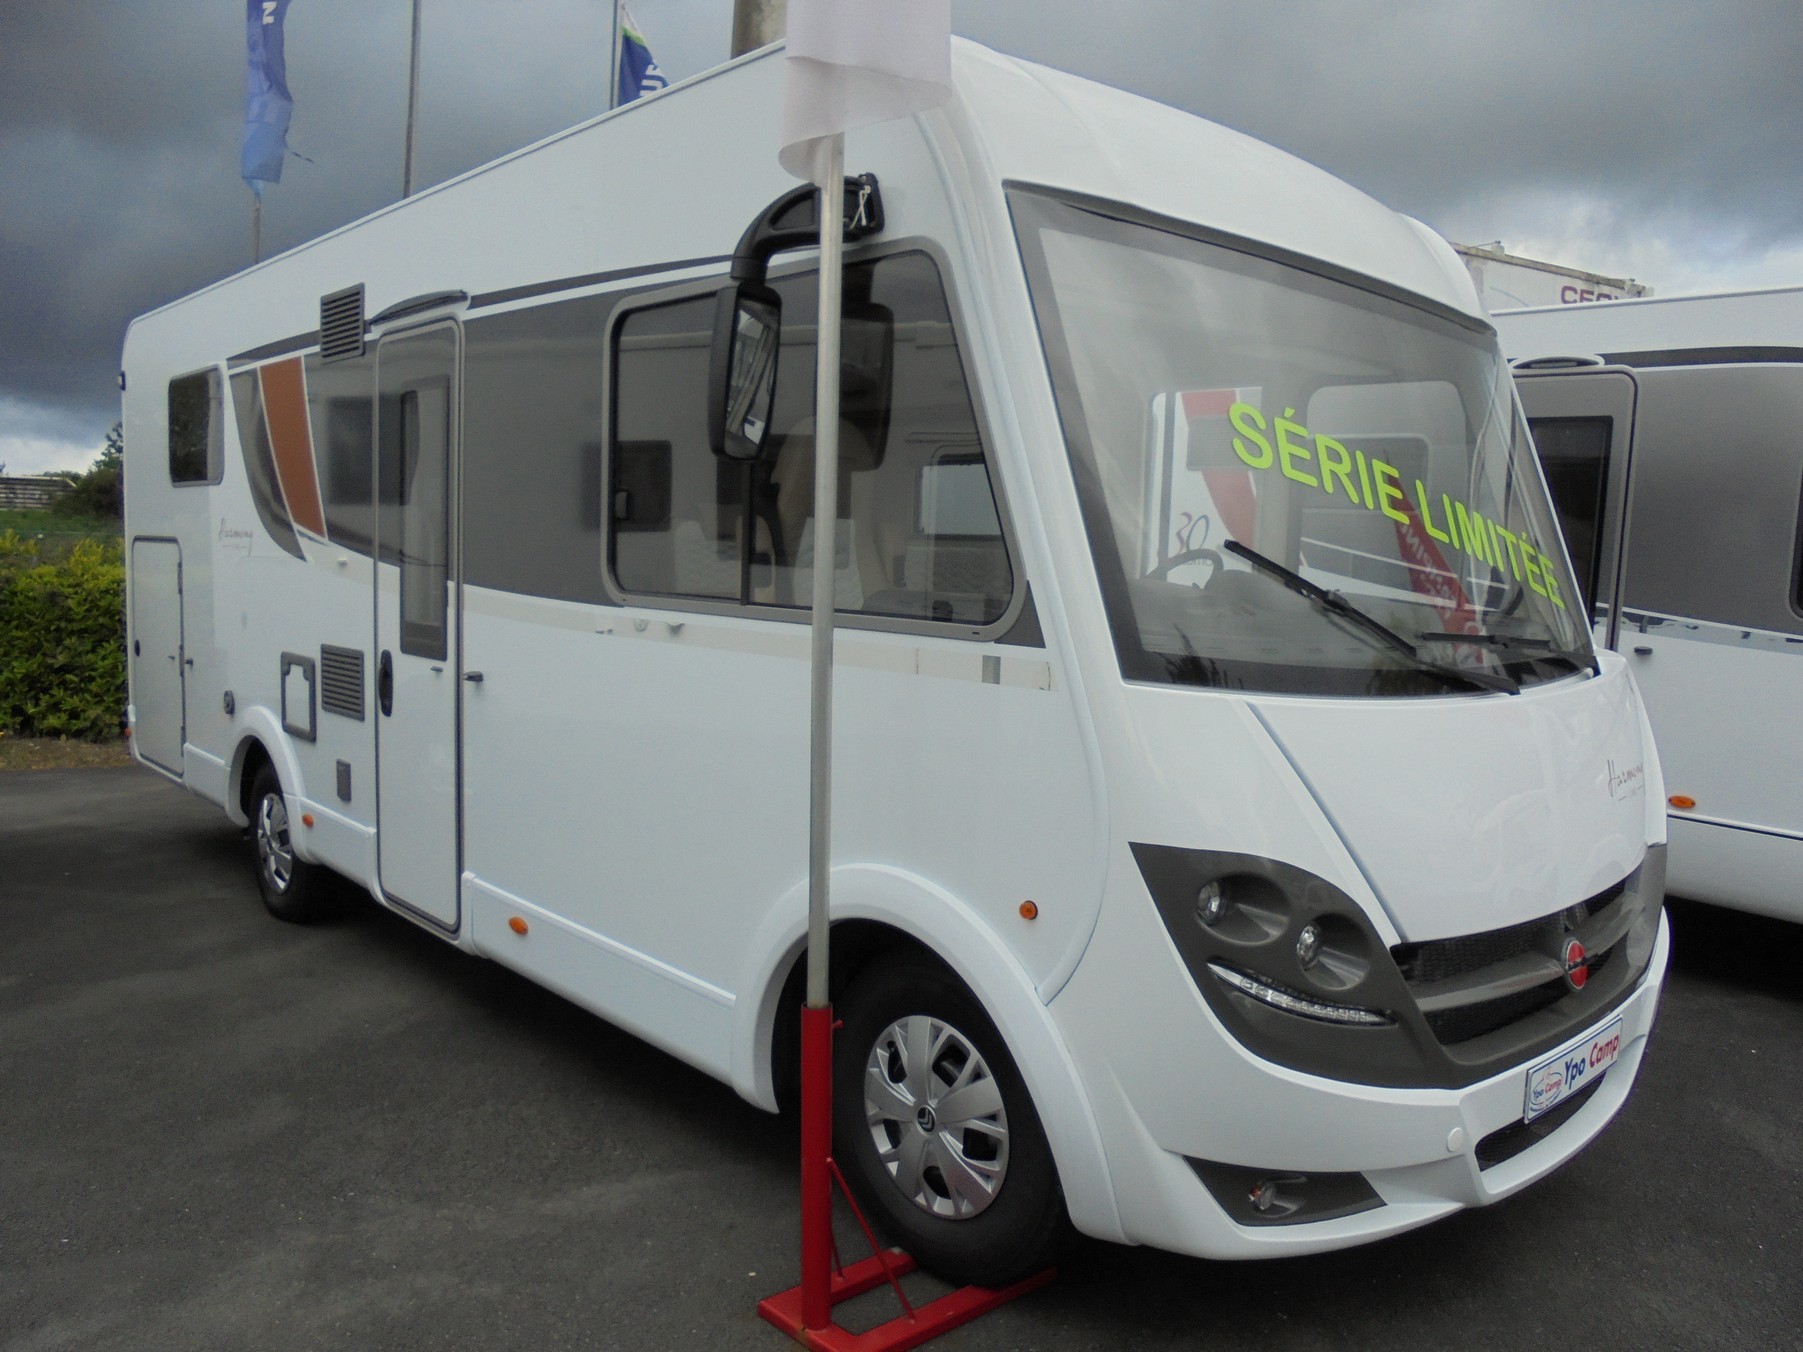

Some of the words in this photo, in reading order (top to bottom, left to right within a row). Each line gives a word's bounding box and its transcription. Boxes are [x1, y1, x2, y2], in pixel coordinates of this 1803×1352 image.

[1229, 402, 1410, 526] SÉRIE
[1415, 479, 1566, 610] LIMITÉE
[1564, 1057, 1586, 1090] Ypo
[1589, 1034, 1620, 1068] Camp
